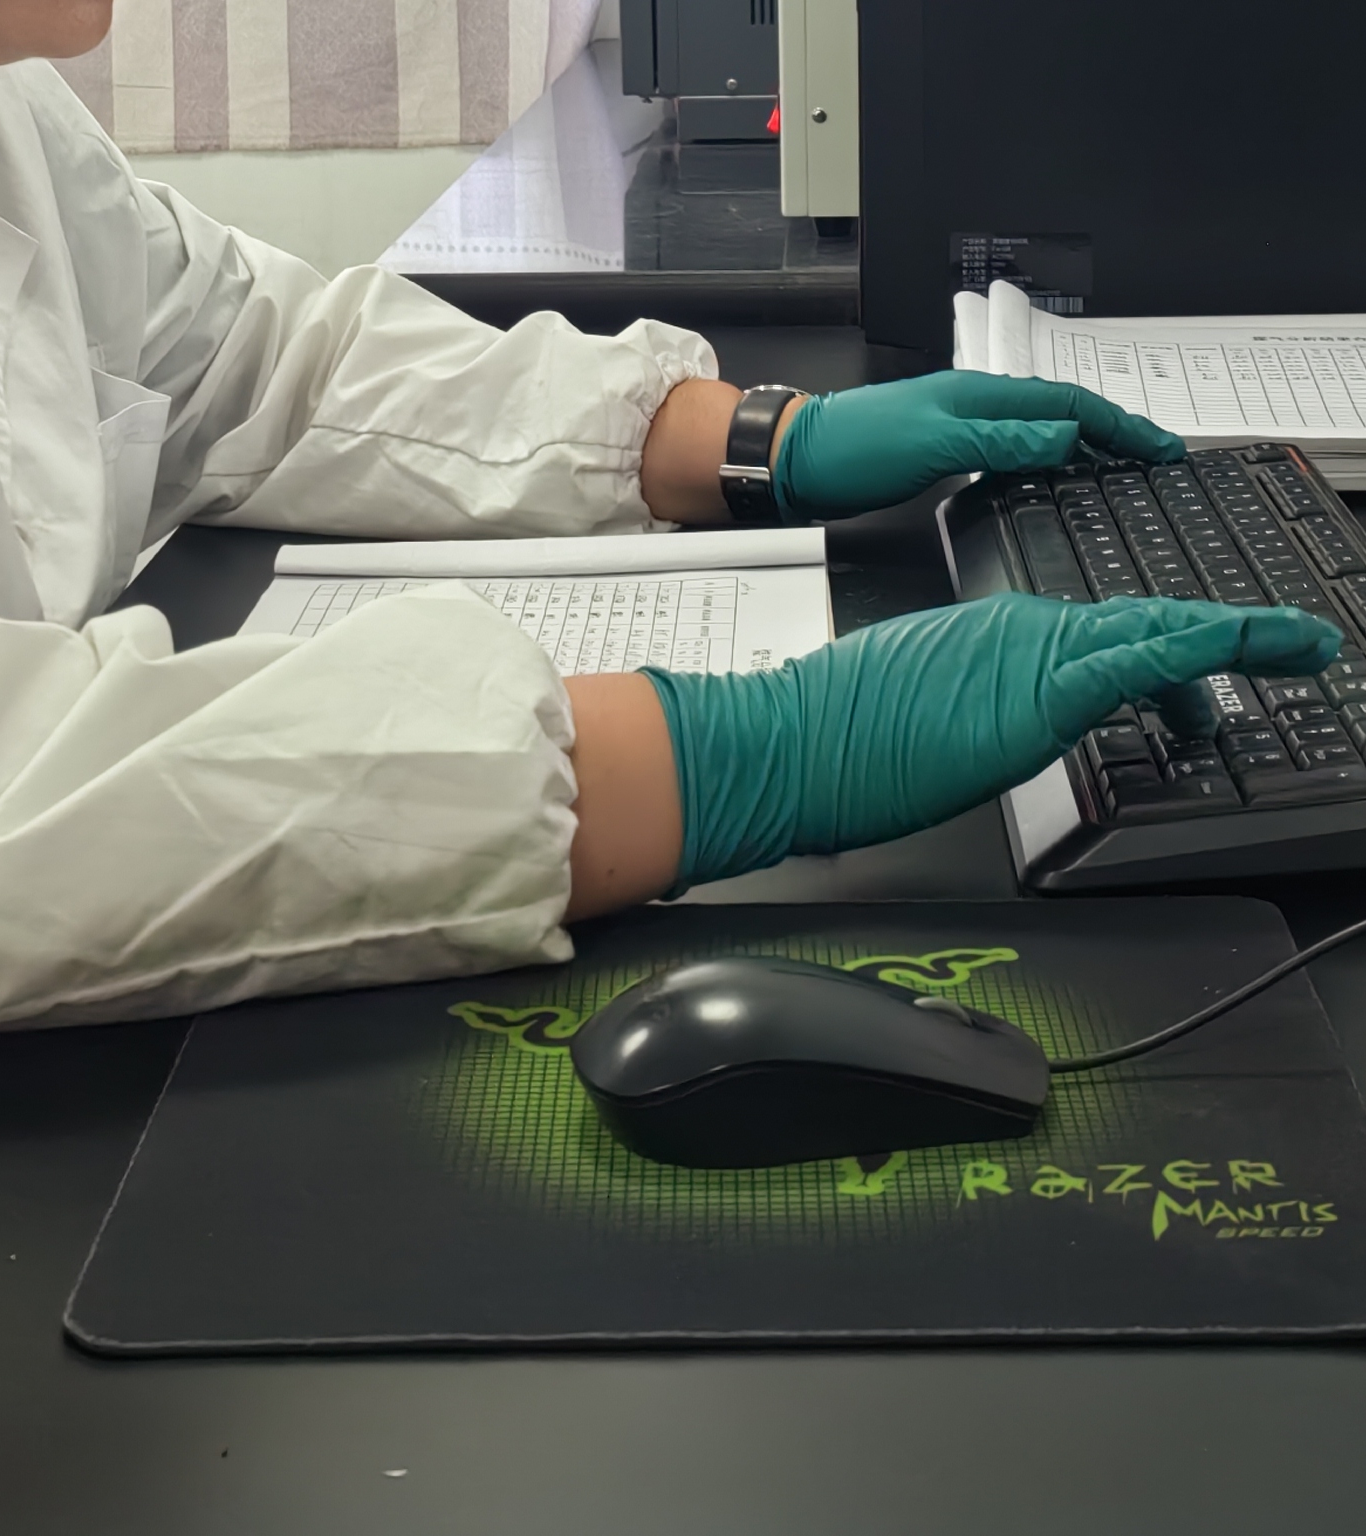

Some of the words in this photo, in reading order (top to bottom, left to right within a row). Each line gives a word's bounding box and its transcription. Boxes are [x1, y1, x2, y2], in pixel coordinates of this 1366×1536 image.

[1207, 675, 1244, 713] ERAZER
[1152, 1191, 1338, 1241] MANTIS
[1216, 1226, 1325, 1239] SPEED
